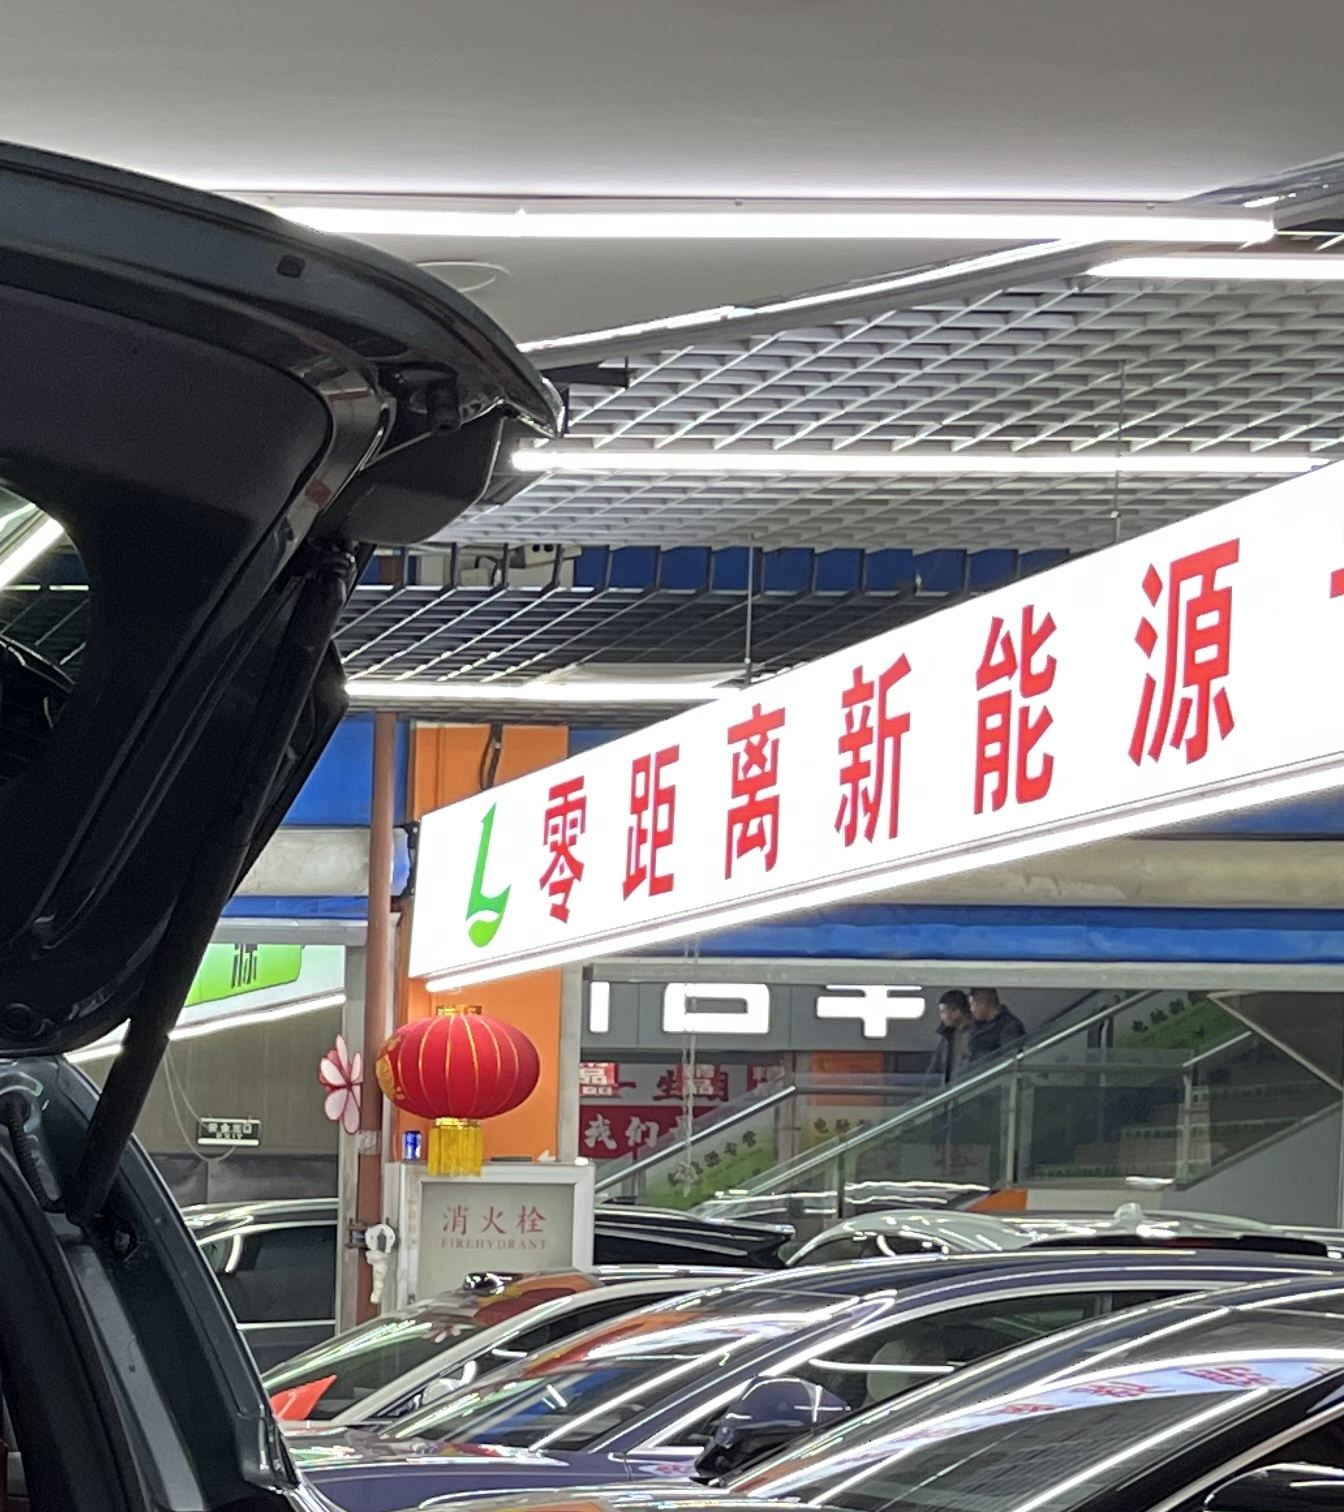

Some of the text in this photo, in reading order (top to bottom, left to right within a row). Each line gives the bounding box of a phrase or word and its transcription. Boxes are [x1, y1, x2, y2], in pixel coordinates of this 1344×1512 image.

[539, 538, 1344, 925] 零距离新能源
[442, 1204, 547, 1236] 消火栓
